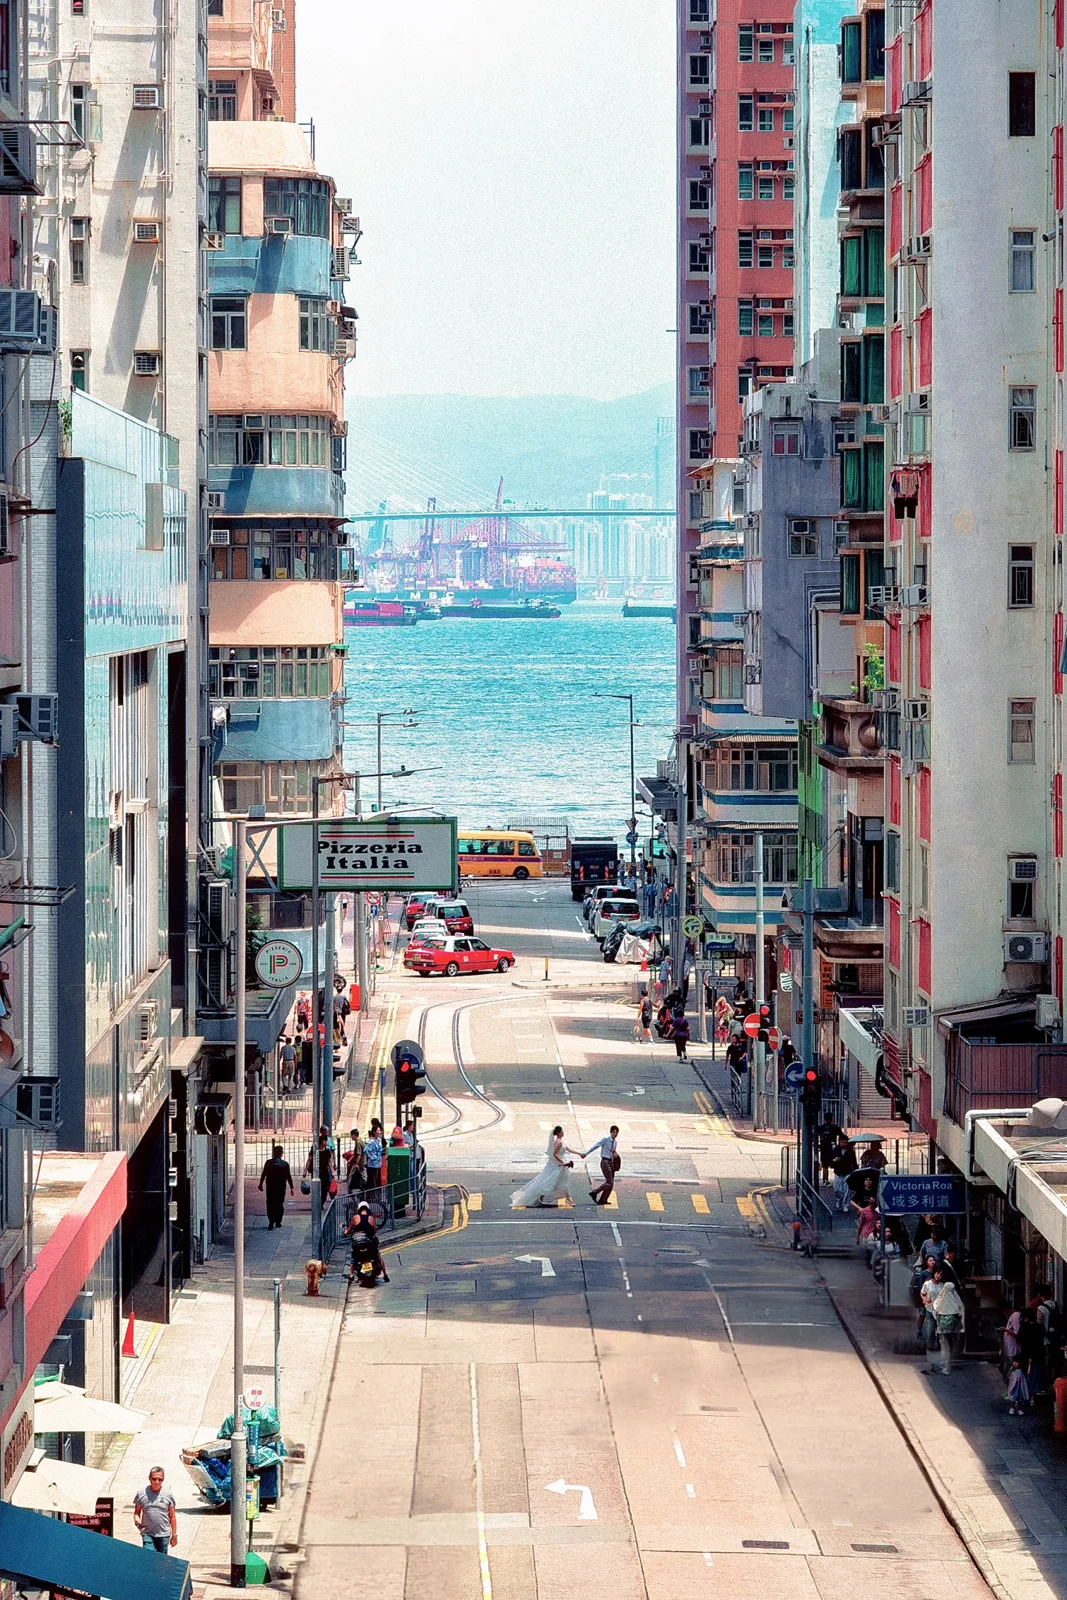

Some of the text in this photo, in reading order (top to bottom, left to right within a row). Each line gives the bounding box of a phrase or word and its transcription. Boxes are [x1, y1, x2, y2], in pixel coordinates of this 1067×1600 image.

[318, 841, 423, 854] Pizzeria
[326, 856, 409, 869] Italia
[891, 1181, 953, 1191] Victoria Roa
[892, 1195, 949, 1208] 域多利道
